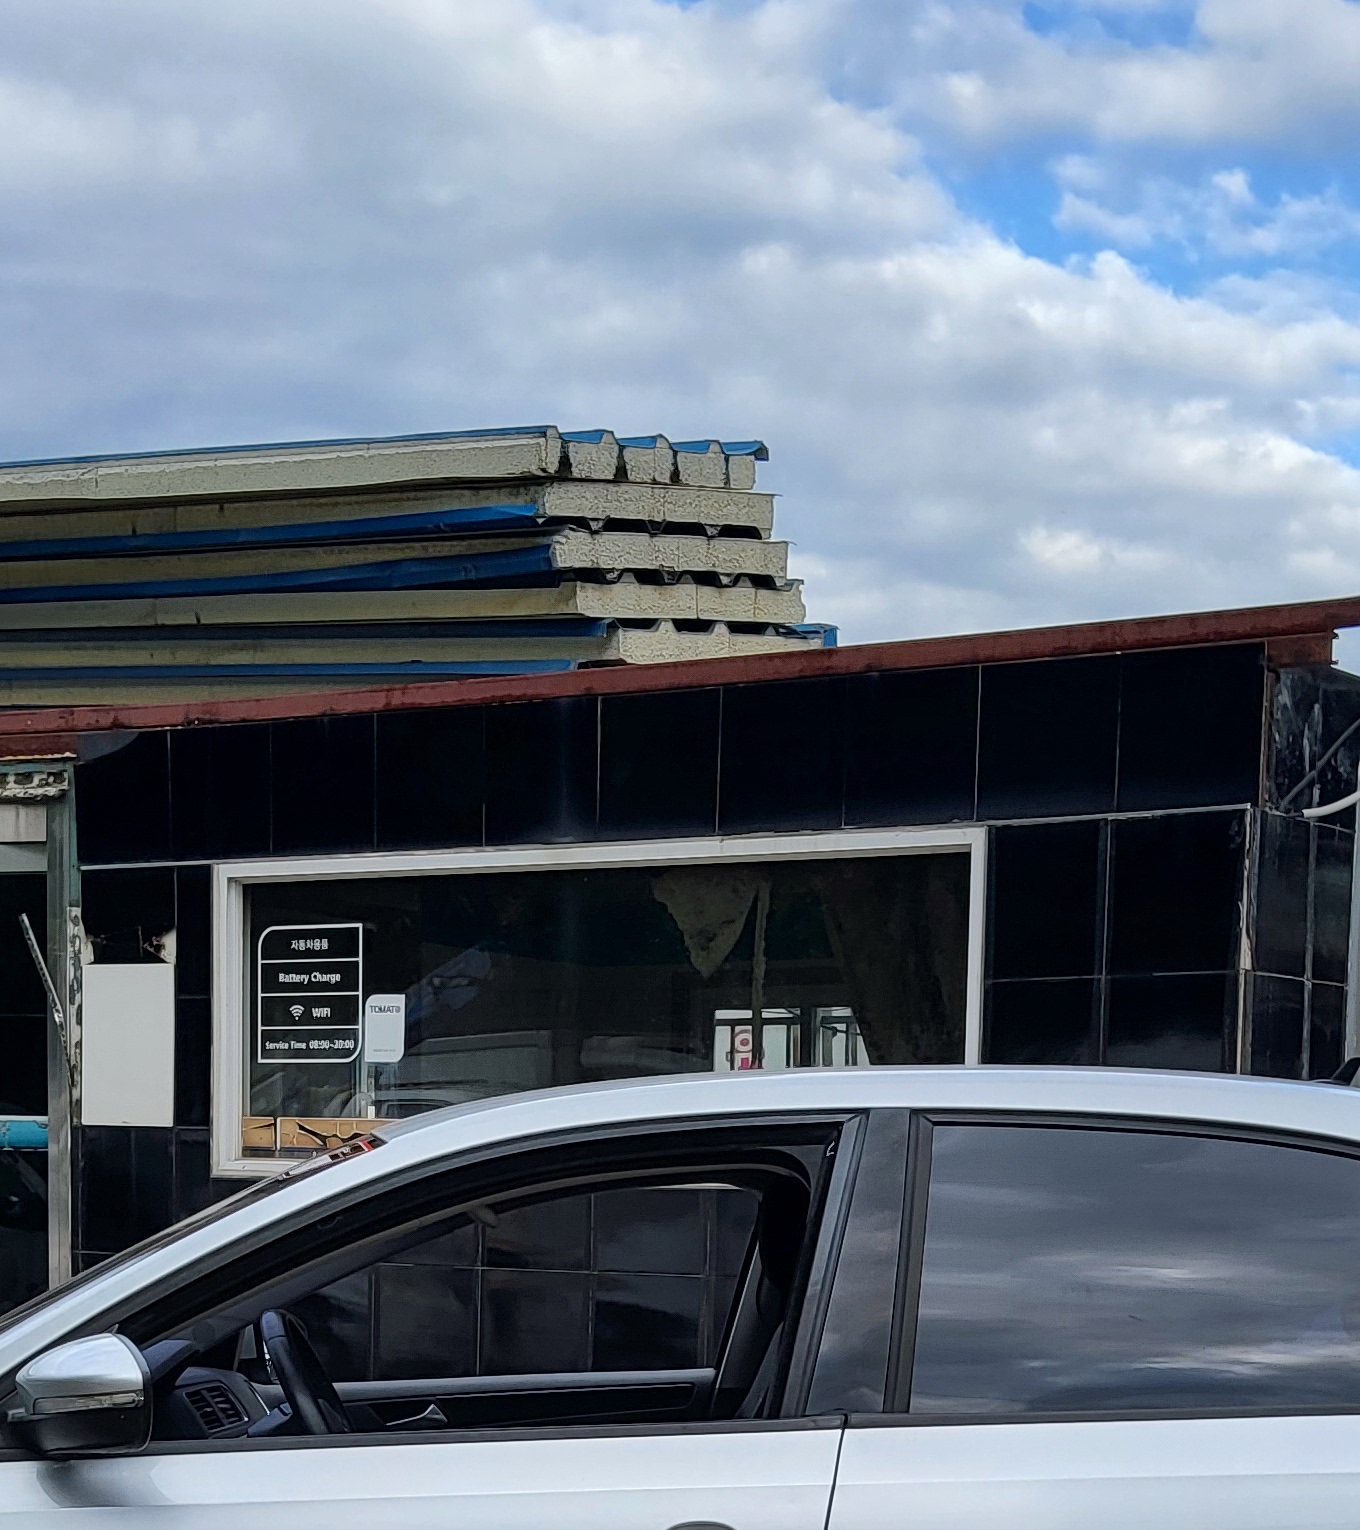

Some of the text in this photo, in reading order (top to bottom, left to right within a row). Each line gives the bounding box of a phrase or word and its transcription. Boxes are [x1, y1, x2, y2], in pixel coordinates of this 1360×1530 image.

[278, 972, 310, 985] Battery
[265, 1040, 289, 1050] Service
[290, 1040, 307, 1050] Time
